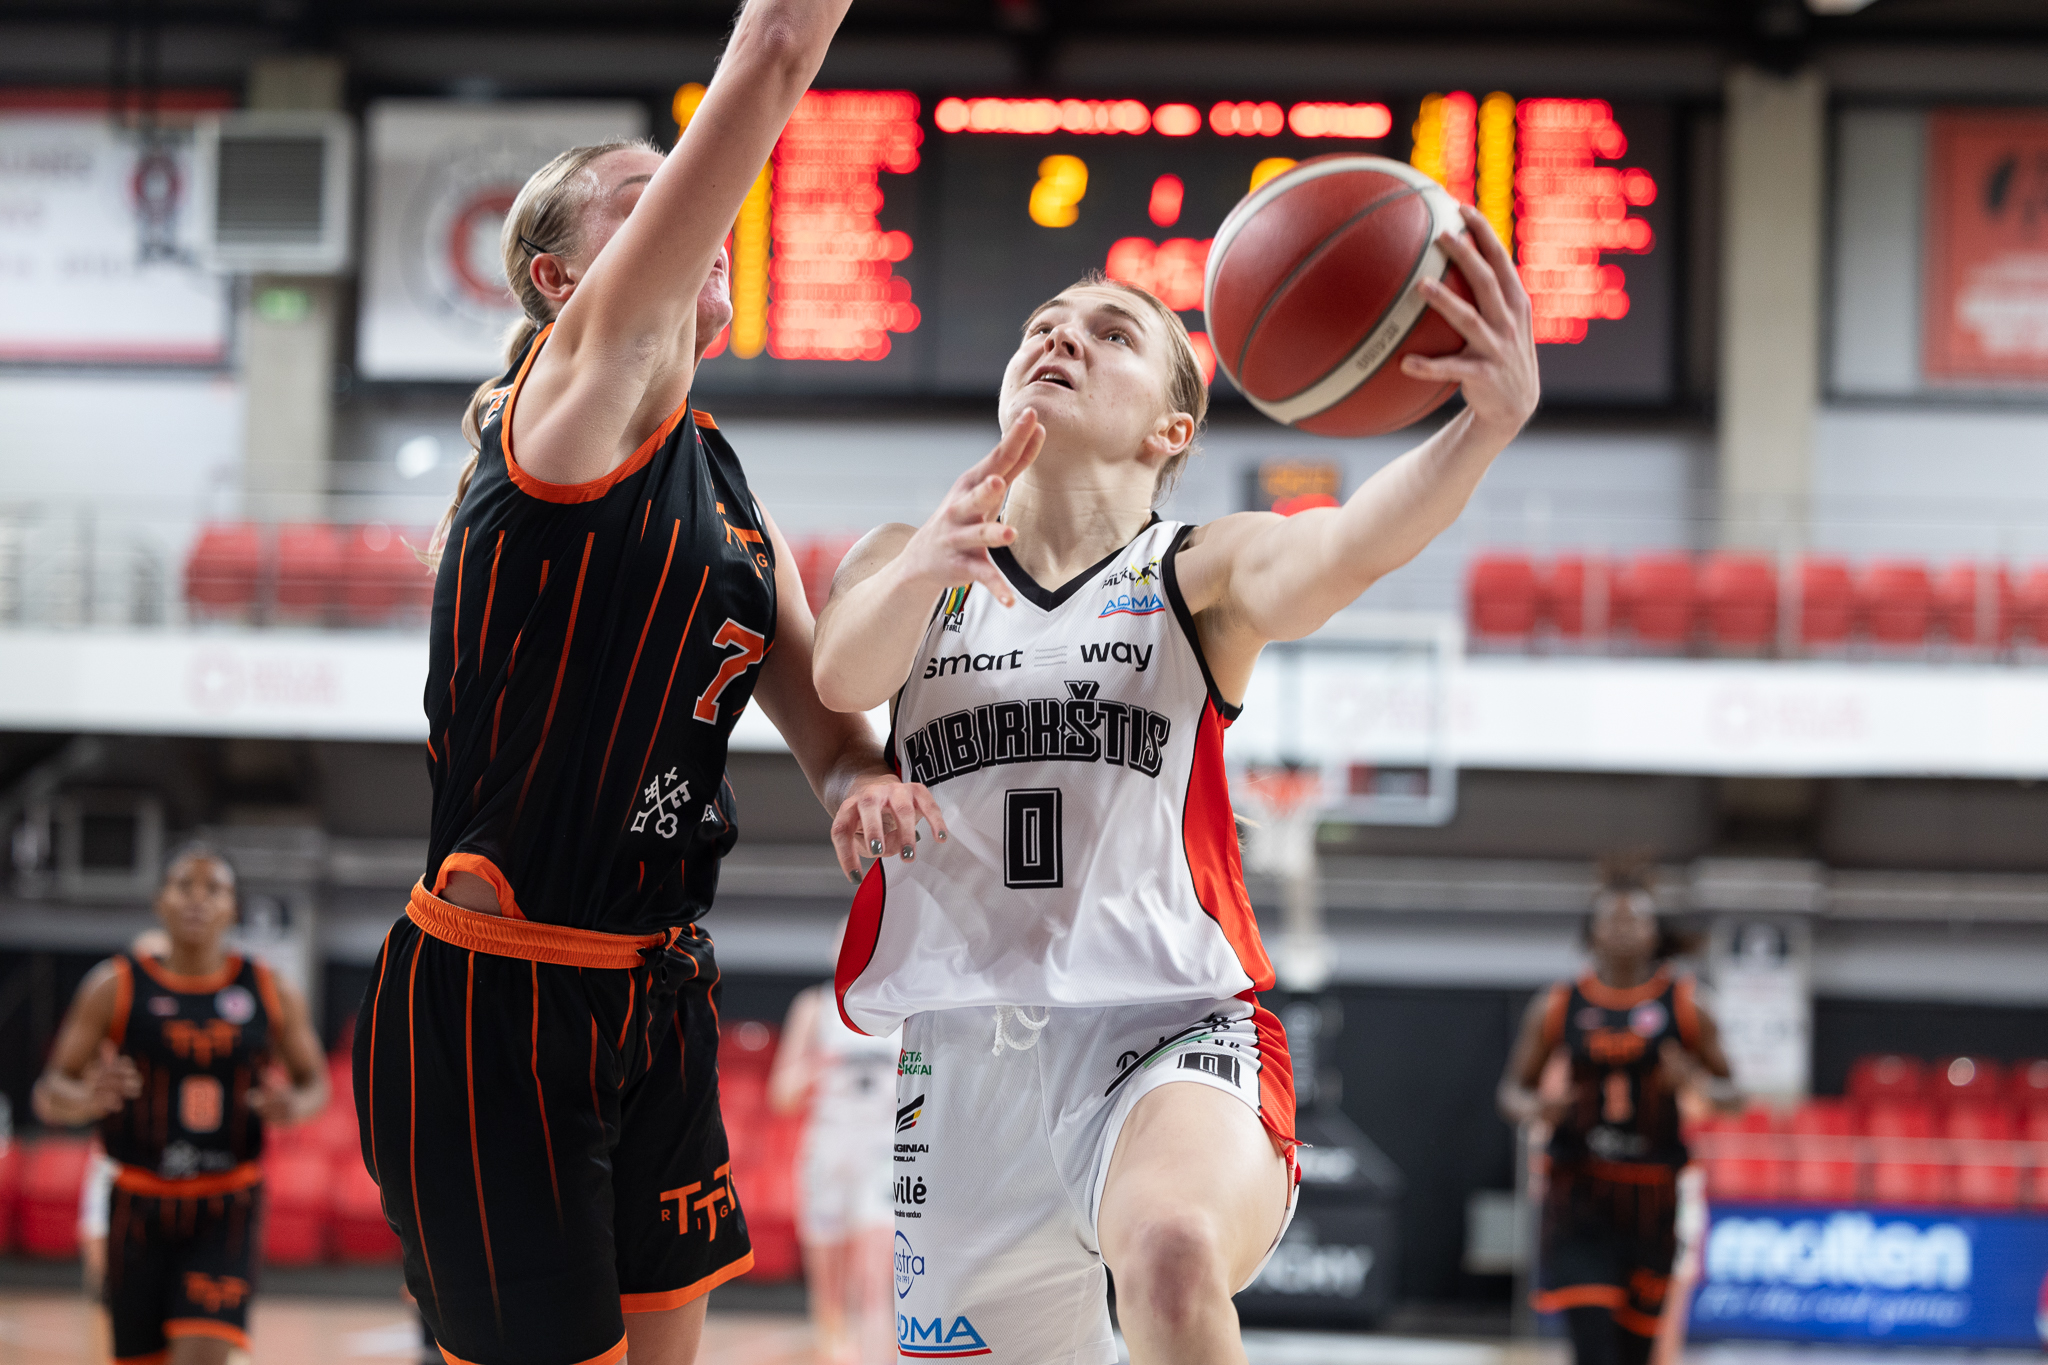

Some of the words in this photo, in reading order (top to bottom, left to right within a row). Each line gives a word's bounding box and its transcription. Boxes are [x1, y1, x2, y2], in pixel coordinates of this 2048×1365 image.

[693, 617, 765, 725] 7
[923, 649, 1024, 680] smart
[1080, 641, 1154, 673] way
[903, 680, 1171, 788] KIBIRKŠTIS
[1004, 787, 1064, 889] 0
[660, 1204, 730, 1231] RIG
[1707, 1214, 1974, 1291] molten
